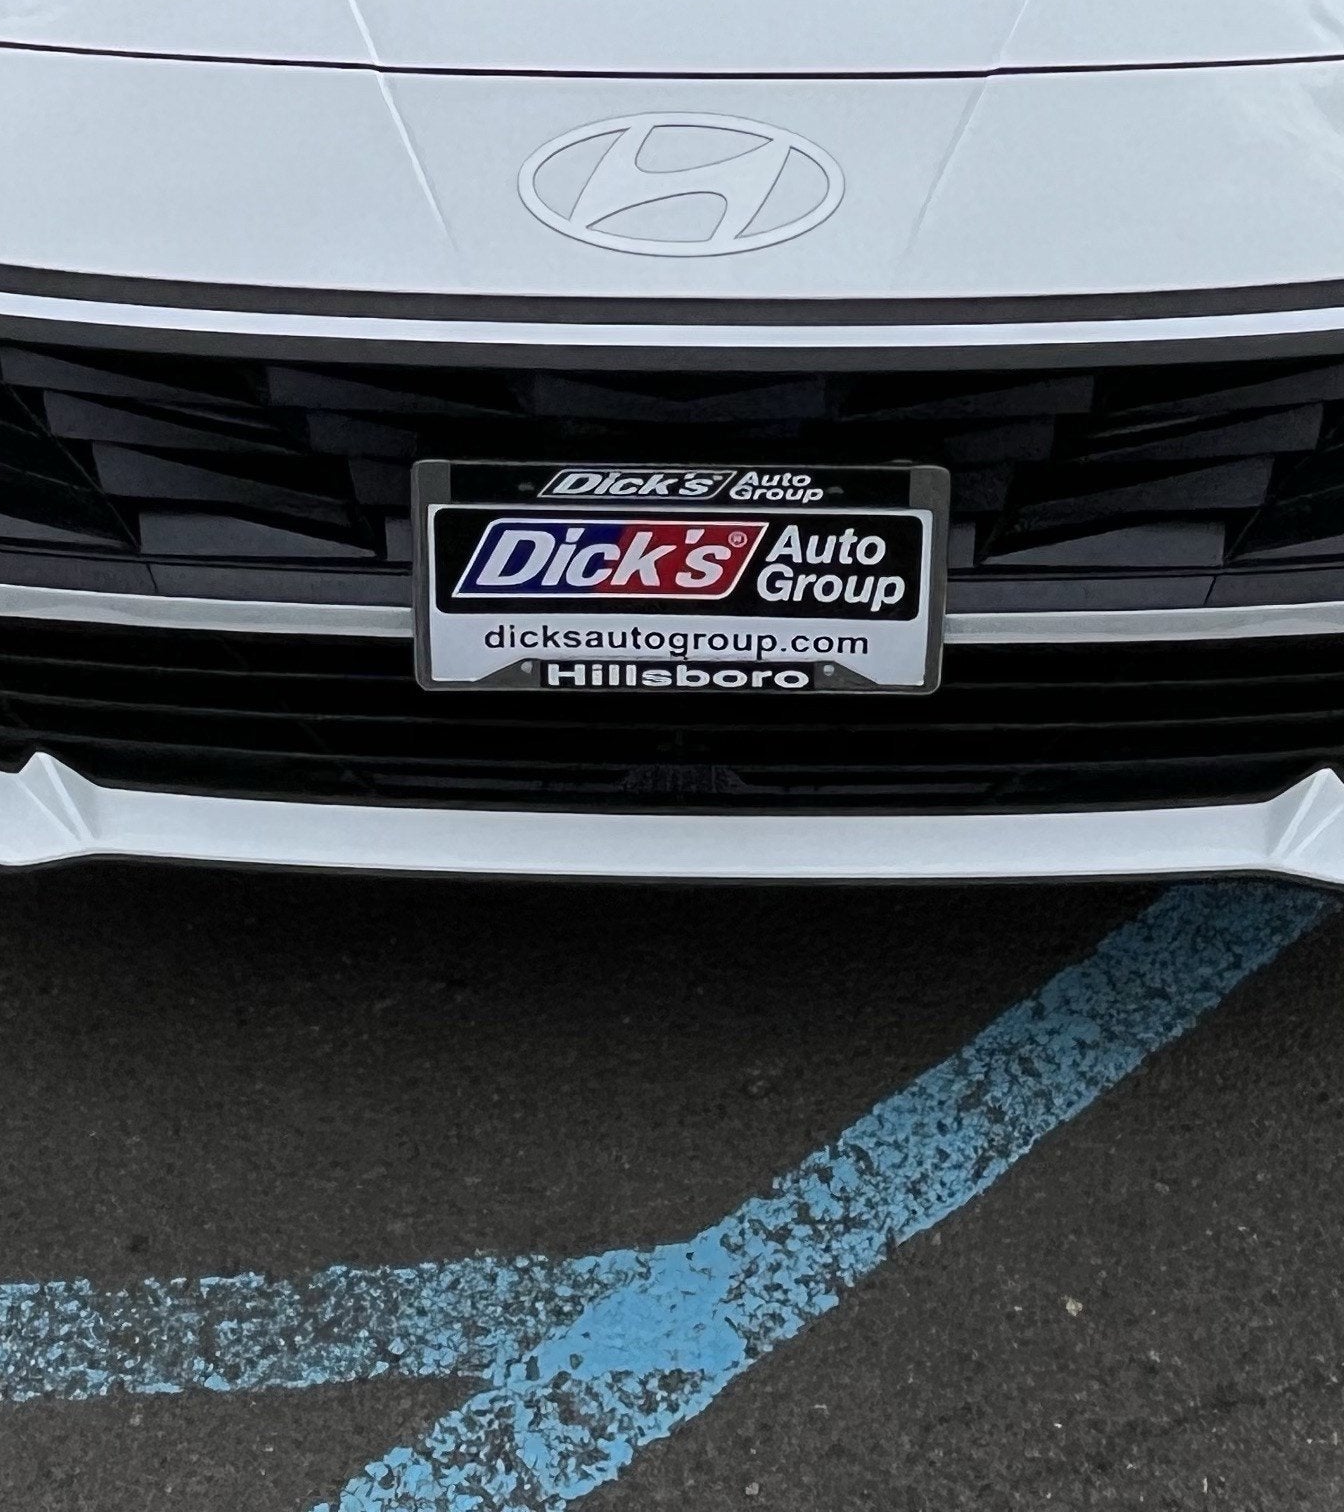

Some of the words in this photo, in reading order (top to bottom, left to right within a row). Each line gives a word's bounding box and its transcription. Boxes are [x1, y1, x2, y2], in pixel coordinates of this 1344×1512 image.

[552, 472, 714, 496] Dick's
[729, 484, 824, 503] Group
[736, 471, 812, 488] Auto
[475, 528, 732, 587] Dick's
[766, 525, 887, 565] Auto
[757, 563, 906, 612] Group
[484, 625, 869, 657] dicksautogroup.com
[547, 663, 810, 689] Hillsboro
